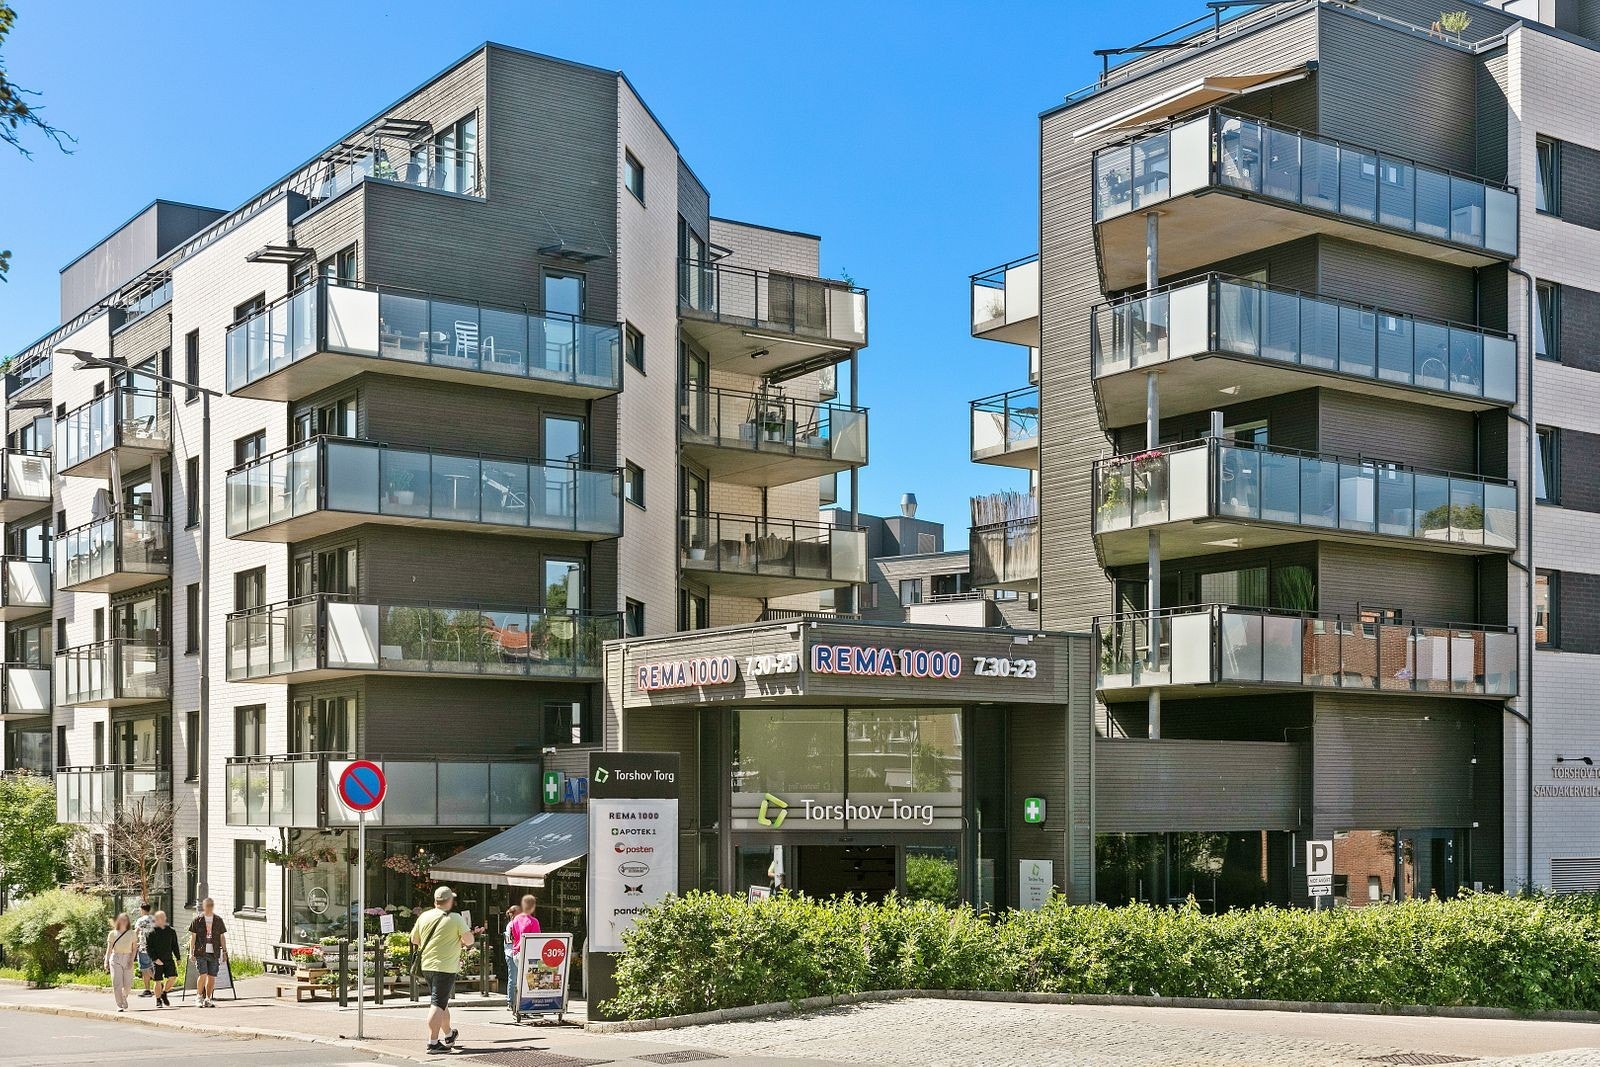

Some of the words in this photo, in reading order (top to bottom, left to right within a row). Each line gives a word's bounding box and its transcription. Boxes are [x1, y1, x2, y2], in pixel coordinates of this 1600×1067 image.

[811, 645, 897, 676] REMA
[900, 648, 962, 679] 1000
[637, 661, 689, 691] REMA
[689, 655, 736, 687] 1000
[614, 769, 652, 781] Torshov
[654, 769, 675, 783] Torg
[1551, 767, 1595, 779] TORSHOV
[608, 812, 637, 820] REMA
[638, 812, 660, 820] 1000
[800, 799, 883, 820] Torshov
[887, 798, 934, 826] Torg
[619, 828, 651, 836] APOTEK
[651, 828, 657, 836] 1
[625, 845, 655, 854] posten
[1311, 843, 1328, 872] P
[543, 948, 565, 958] -30%
